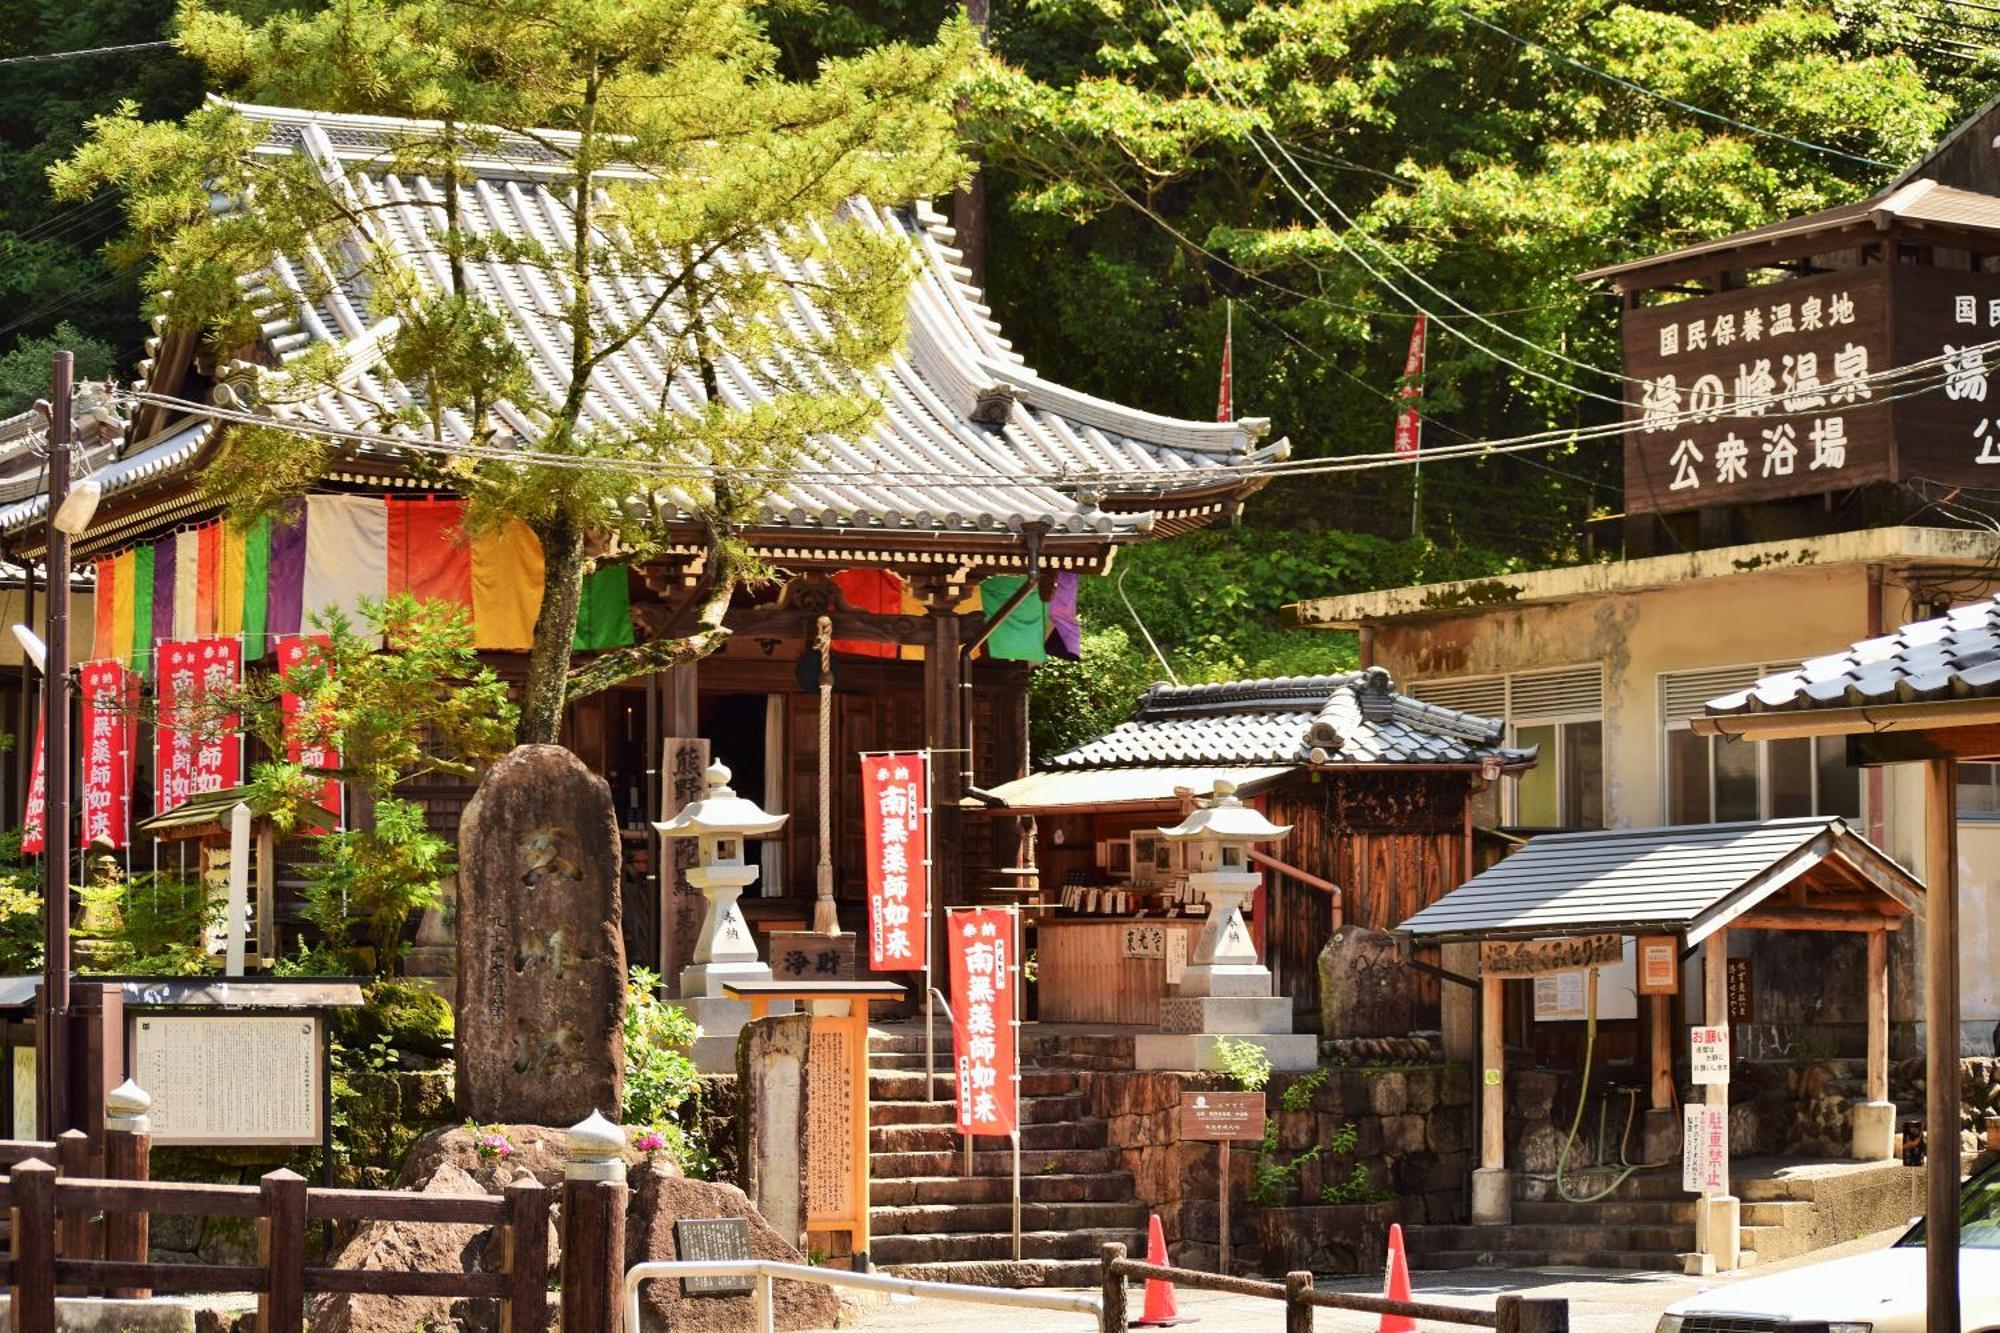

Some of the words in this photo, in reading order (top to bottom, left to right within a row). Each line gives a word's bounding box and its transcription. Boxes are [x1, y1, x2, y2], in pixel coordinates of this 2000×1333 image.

[1659, 291, 1856, 357] 国民保養温泉地
[1641, 341, 1873, 434] 湯の峰温泉
[1943, 343, 1988, 402] 湯
[1669, 415, 1848, 491] 公衆浴場
[875, 767, 910, 782] 奉納
[878, 784, 913, 960] 南無薬師如来
[962, 922, 997, 938] 奉納
[964, 941, 998, 1124] 南無薬師如来
[1692, 1029, 1728, 1044] お願い
[1706, 1111, 1723, 1188] 駐車禁止
